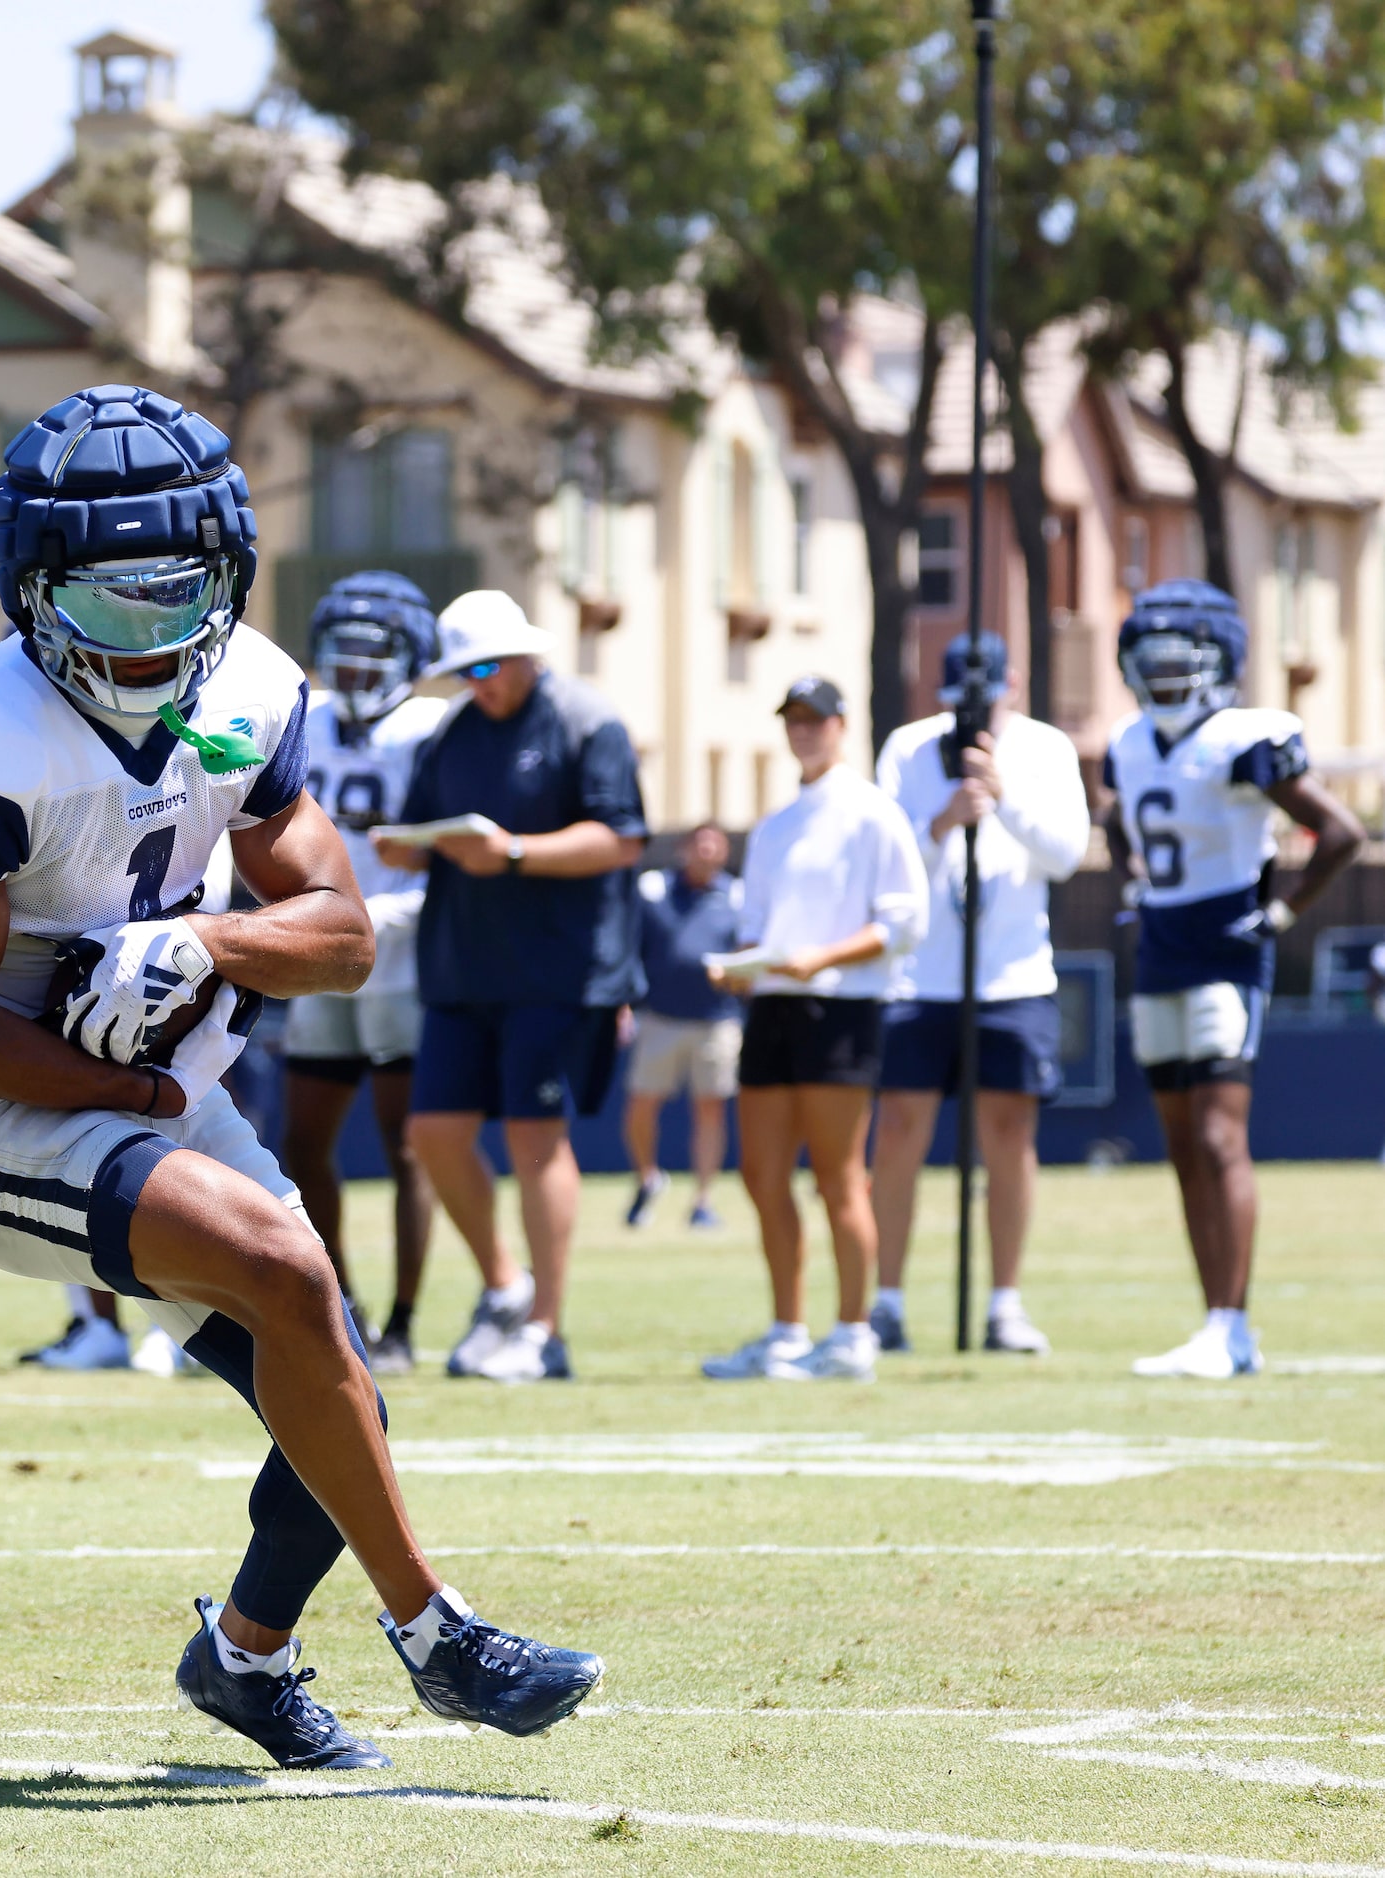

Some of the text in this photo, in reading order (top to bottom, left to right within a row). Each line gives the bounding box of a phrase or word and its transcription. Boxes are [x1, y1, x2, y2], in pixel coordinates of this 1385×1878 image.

[128, 791, 187, 821] COWBOYS
[1136, 789, 1183, 889] 6
[126, 824, 177, 923] 1
